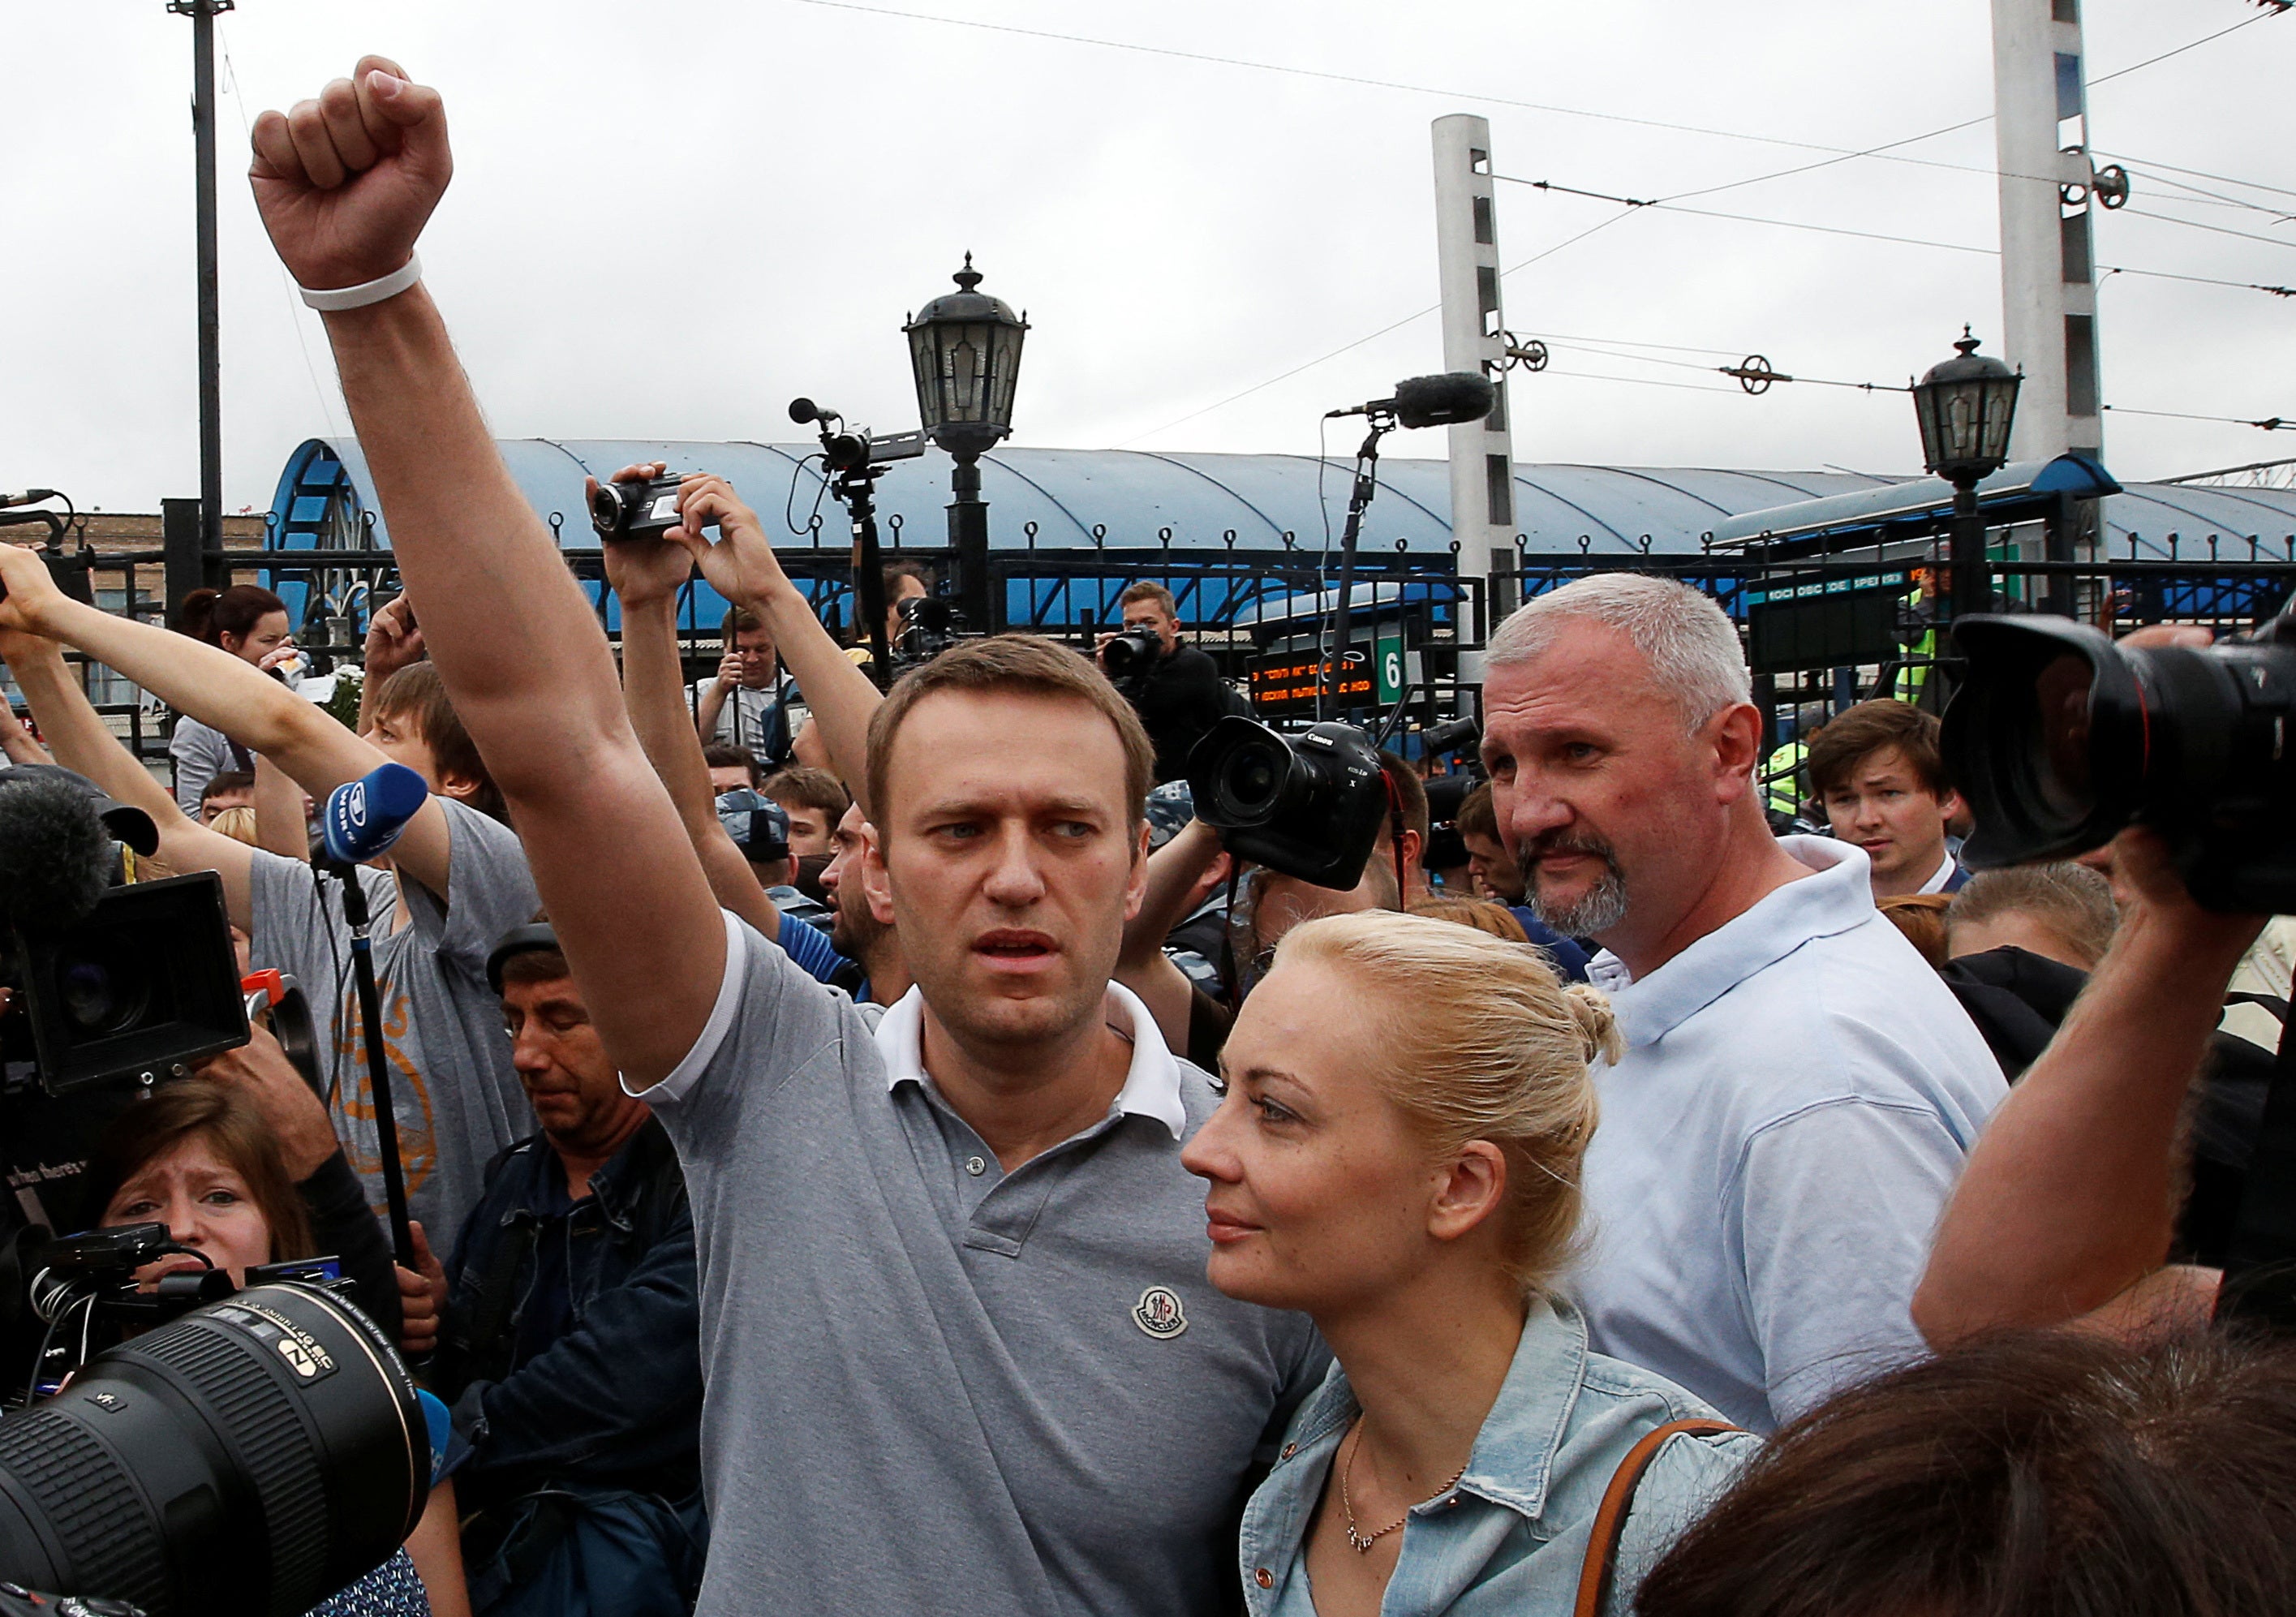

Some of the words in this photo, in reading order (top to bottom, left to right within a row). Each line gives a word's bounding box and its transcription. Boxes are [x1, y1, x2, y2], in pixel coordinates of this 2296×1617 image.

[1769, 580, 1846, 600] ОСОВСОЕ
[1386, 652, 1400, 688] 6
[1307, 733, 1334, 746] Canon
[339, 789, 349, 832] WDR
[1140, 1310, 1179, 1330] MONCLER
